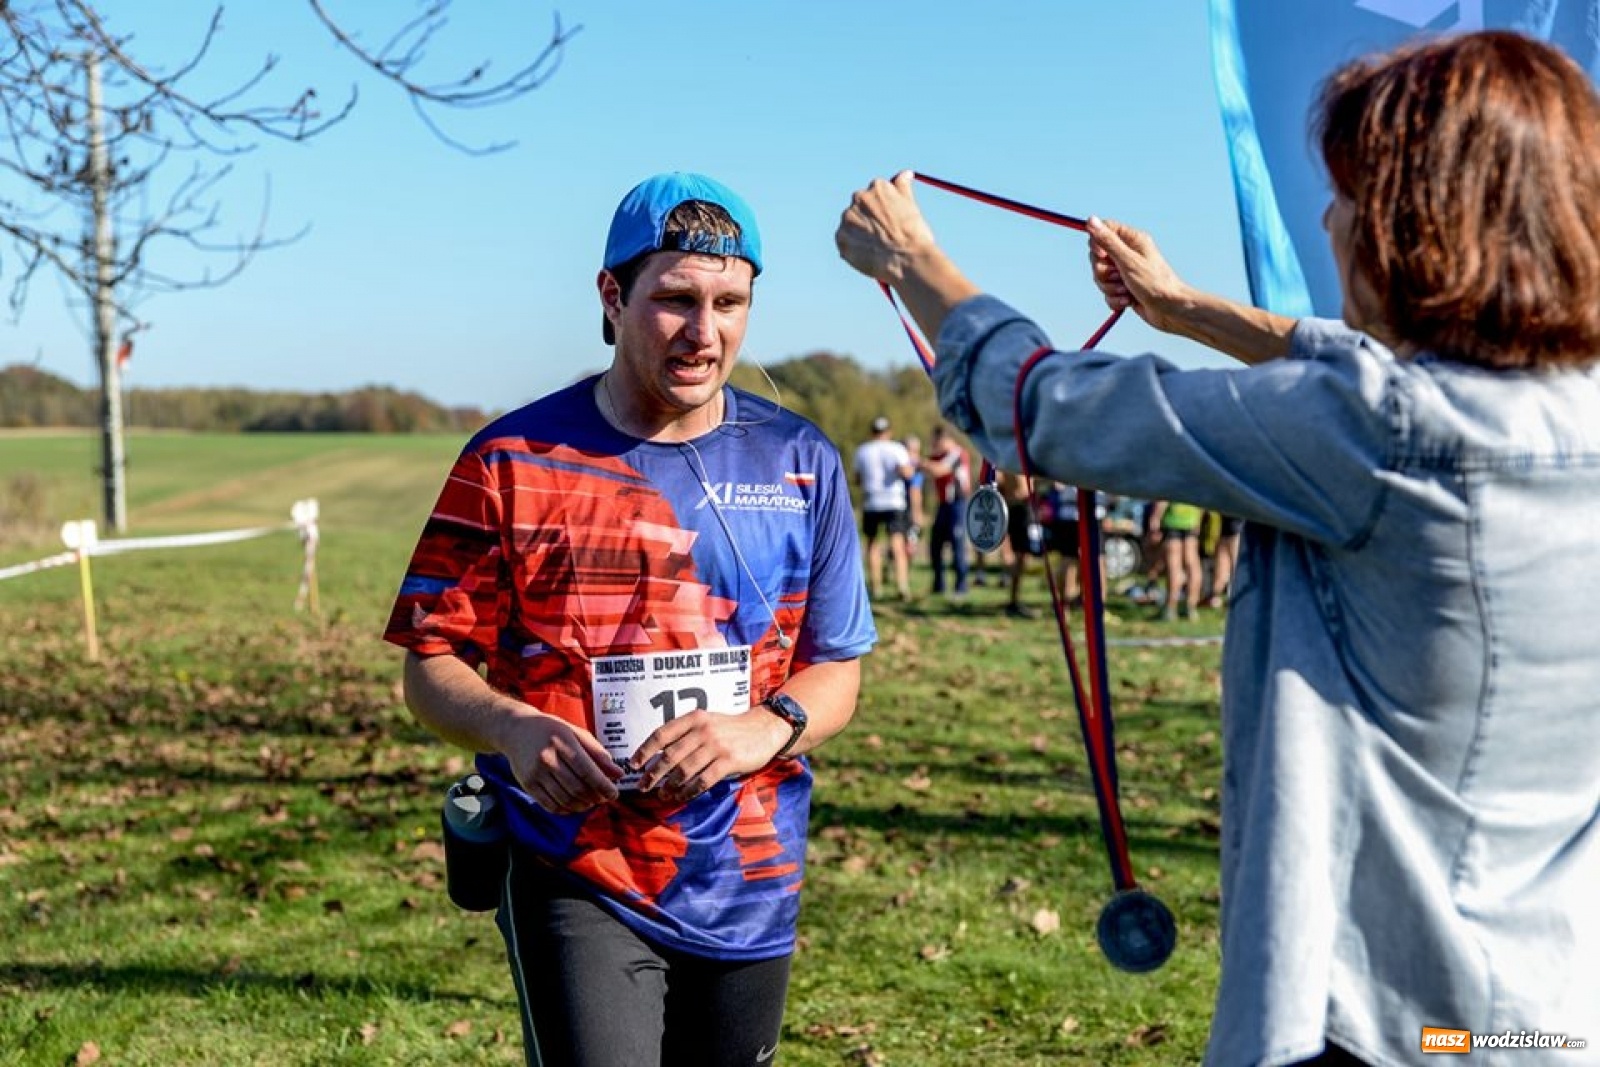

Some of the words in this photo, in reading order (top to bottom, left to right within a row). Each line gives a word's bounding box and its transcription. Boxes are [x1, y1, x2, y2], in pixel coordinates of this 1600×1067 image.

[695, 482, 732, 510] XI
[736, 483, 783, 495] SILESIA
[735, 495, 811, 509] MARATHON
[653, 654, 703, 671] DUKAT
